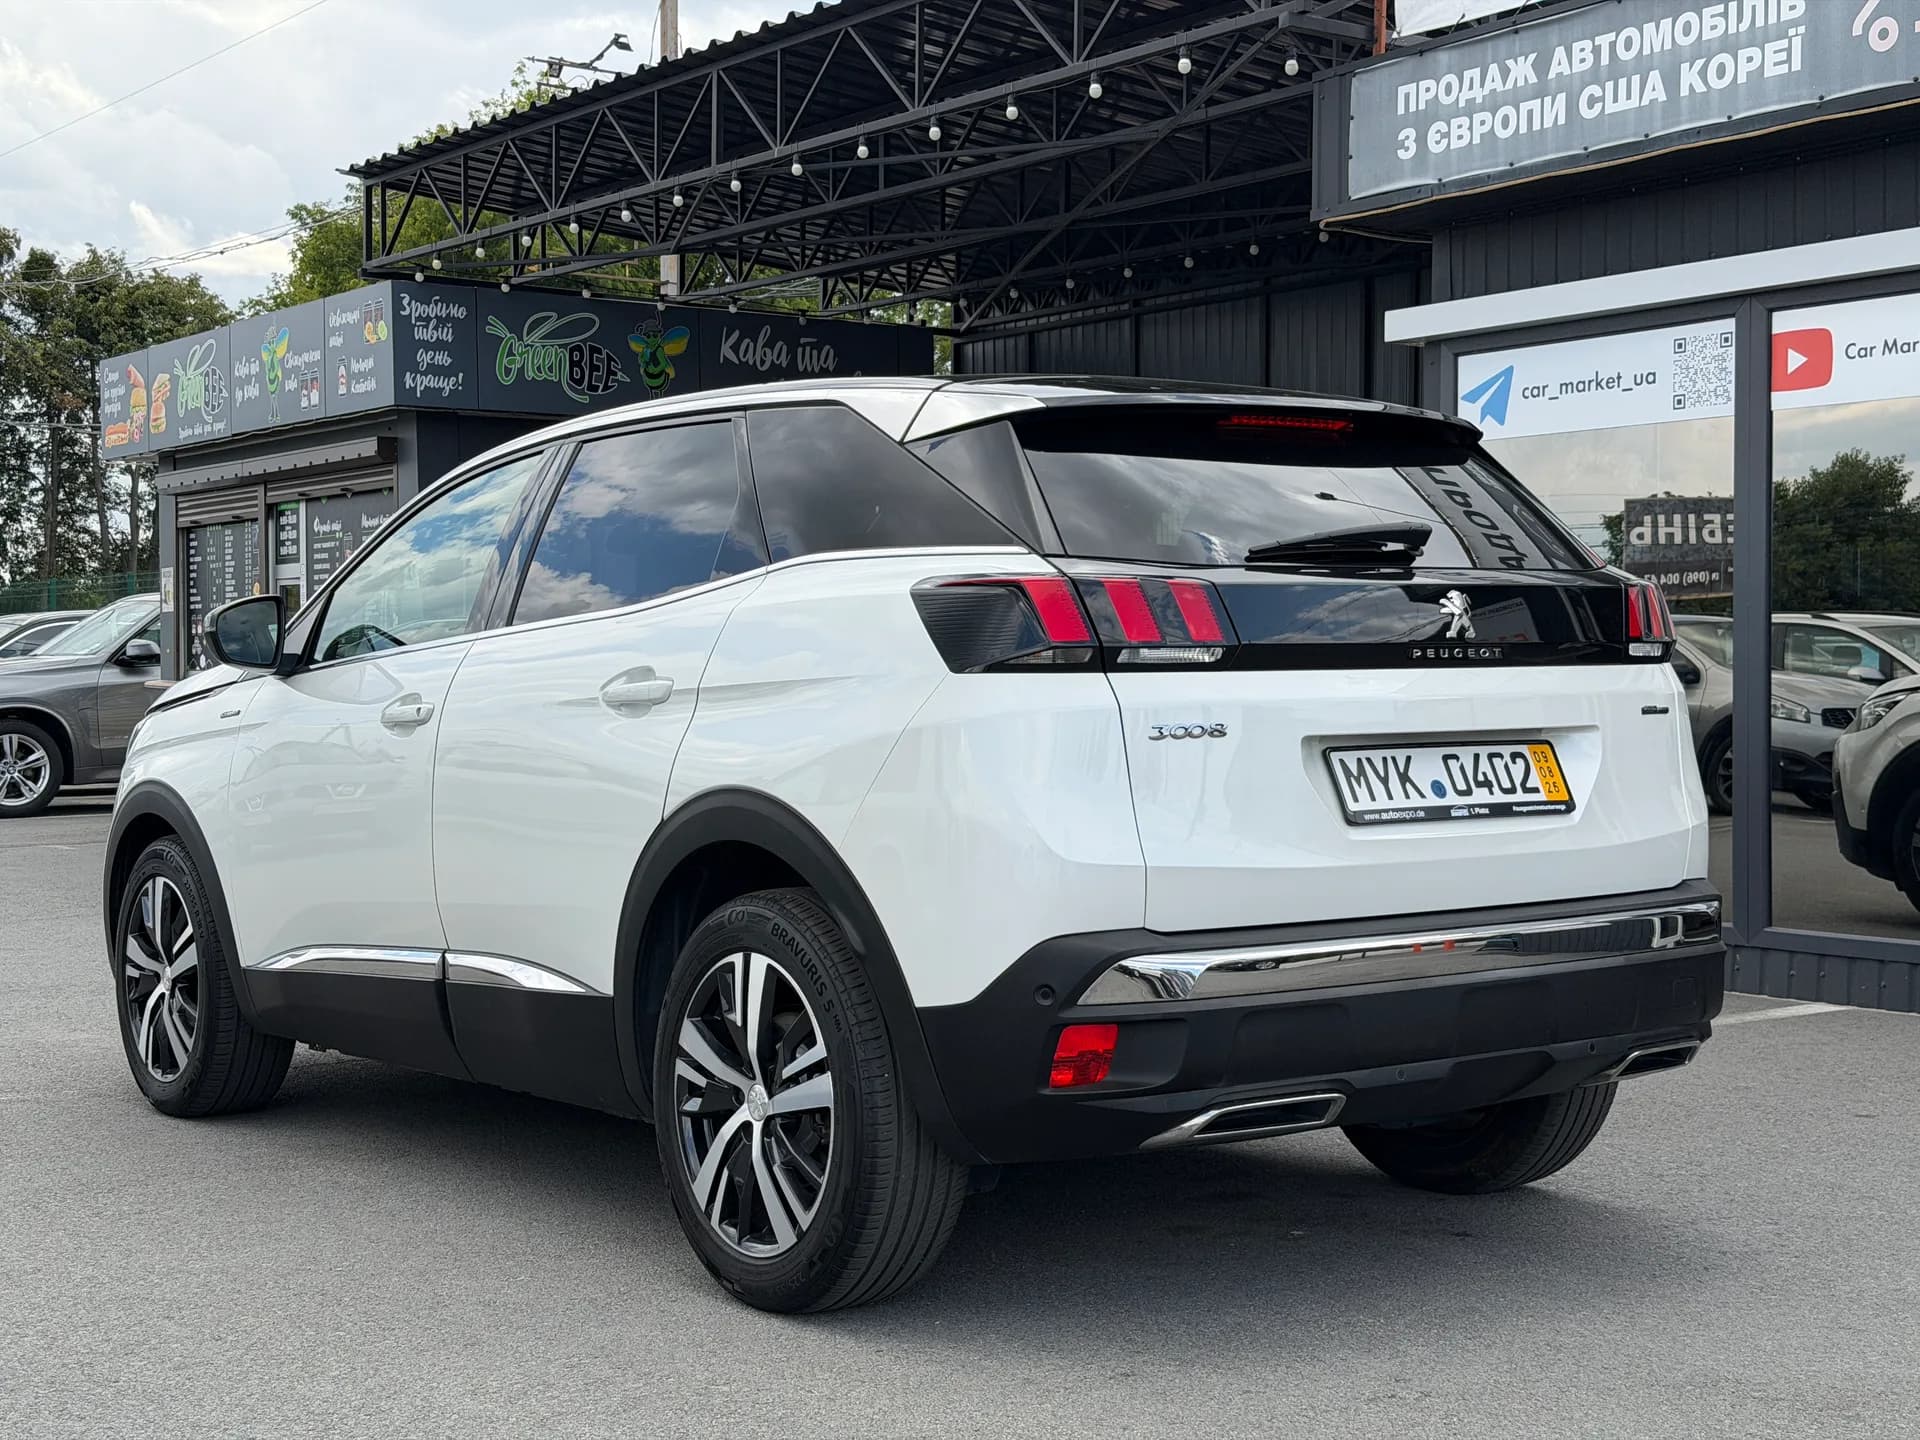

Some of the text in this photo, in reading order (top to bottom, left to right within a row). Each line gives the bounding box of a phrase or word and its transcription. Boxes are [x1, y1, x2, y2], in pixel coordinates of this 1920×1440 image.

[1397, 52, 1538, 115] ПРОДАЖ
[1548, 0, 1806, 80] АВТОМОБІЛІВ
[1397, 127, 1417, 160] З
[1427, 92, 1566, 153] ЄВРОПИ
[1579, 69, 1667, 120] США
[1680, 25, 1806, 96] КОРЕЇ
[400, 293, 467, 324] Зробимо
[414, 318, 454, 342] твій
[417, 348, 453, 371] день
[720, 324, 838, 373] Кава та
[1844, 342, 1876, 360] Car
[404, 371, 463, 398] краще!
[1521, 369, 1657, 401] car_market_ua
[1411, 648, 1503, 660] PEUGEOT
[1148, 721, 1228, 741] 3008
[1533, 751, 1549, 764] 09
[1338, 751, 1541, 803] MYK 0402
[1539, 766, 1554, 778] 08
[1546, 780, 1561, 794] 26
[771, 922, 828, 997] BRAVURIS
[823, 999, 835, 1013] 5
